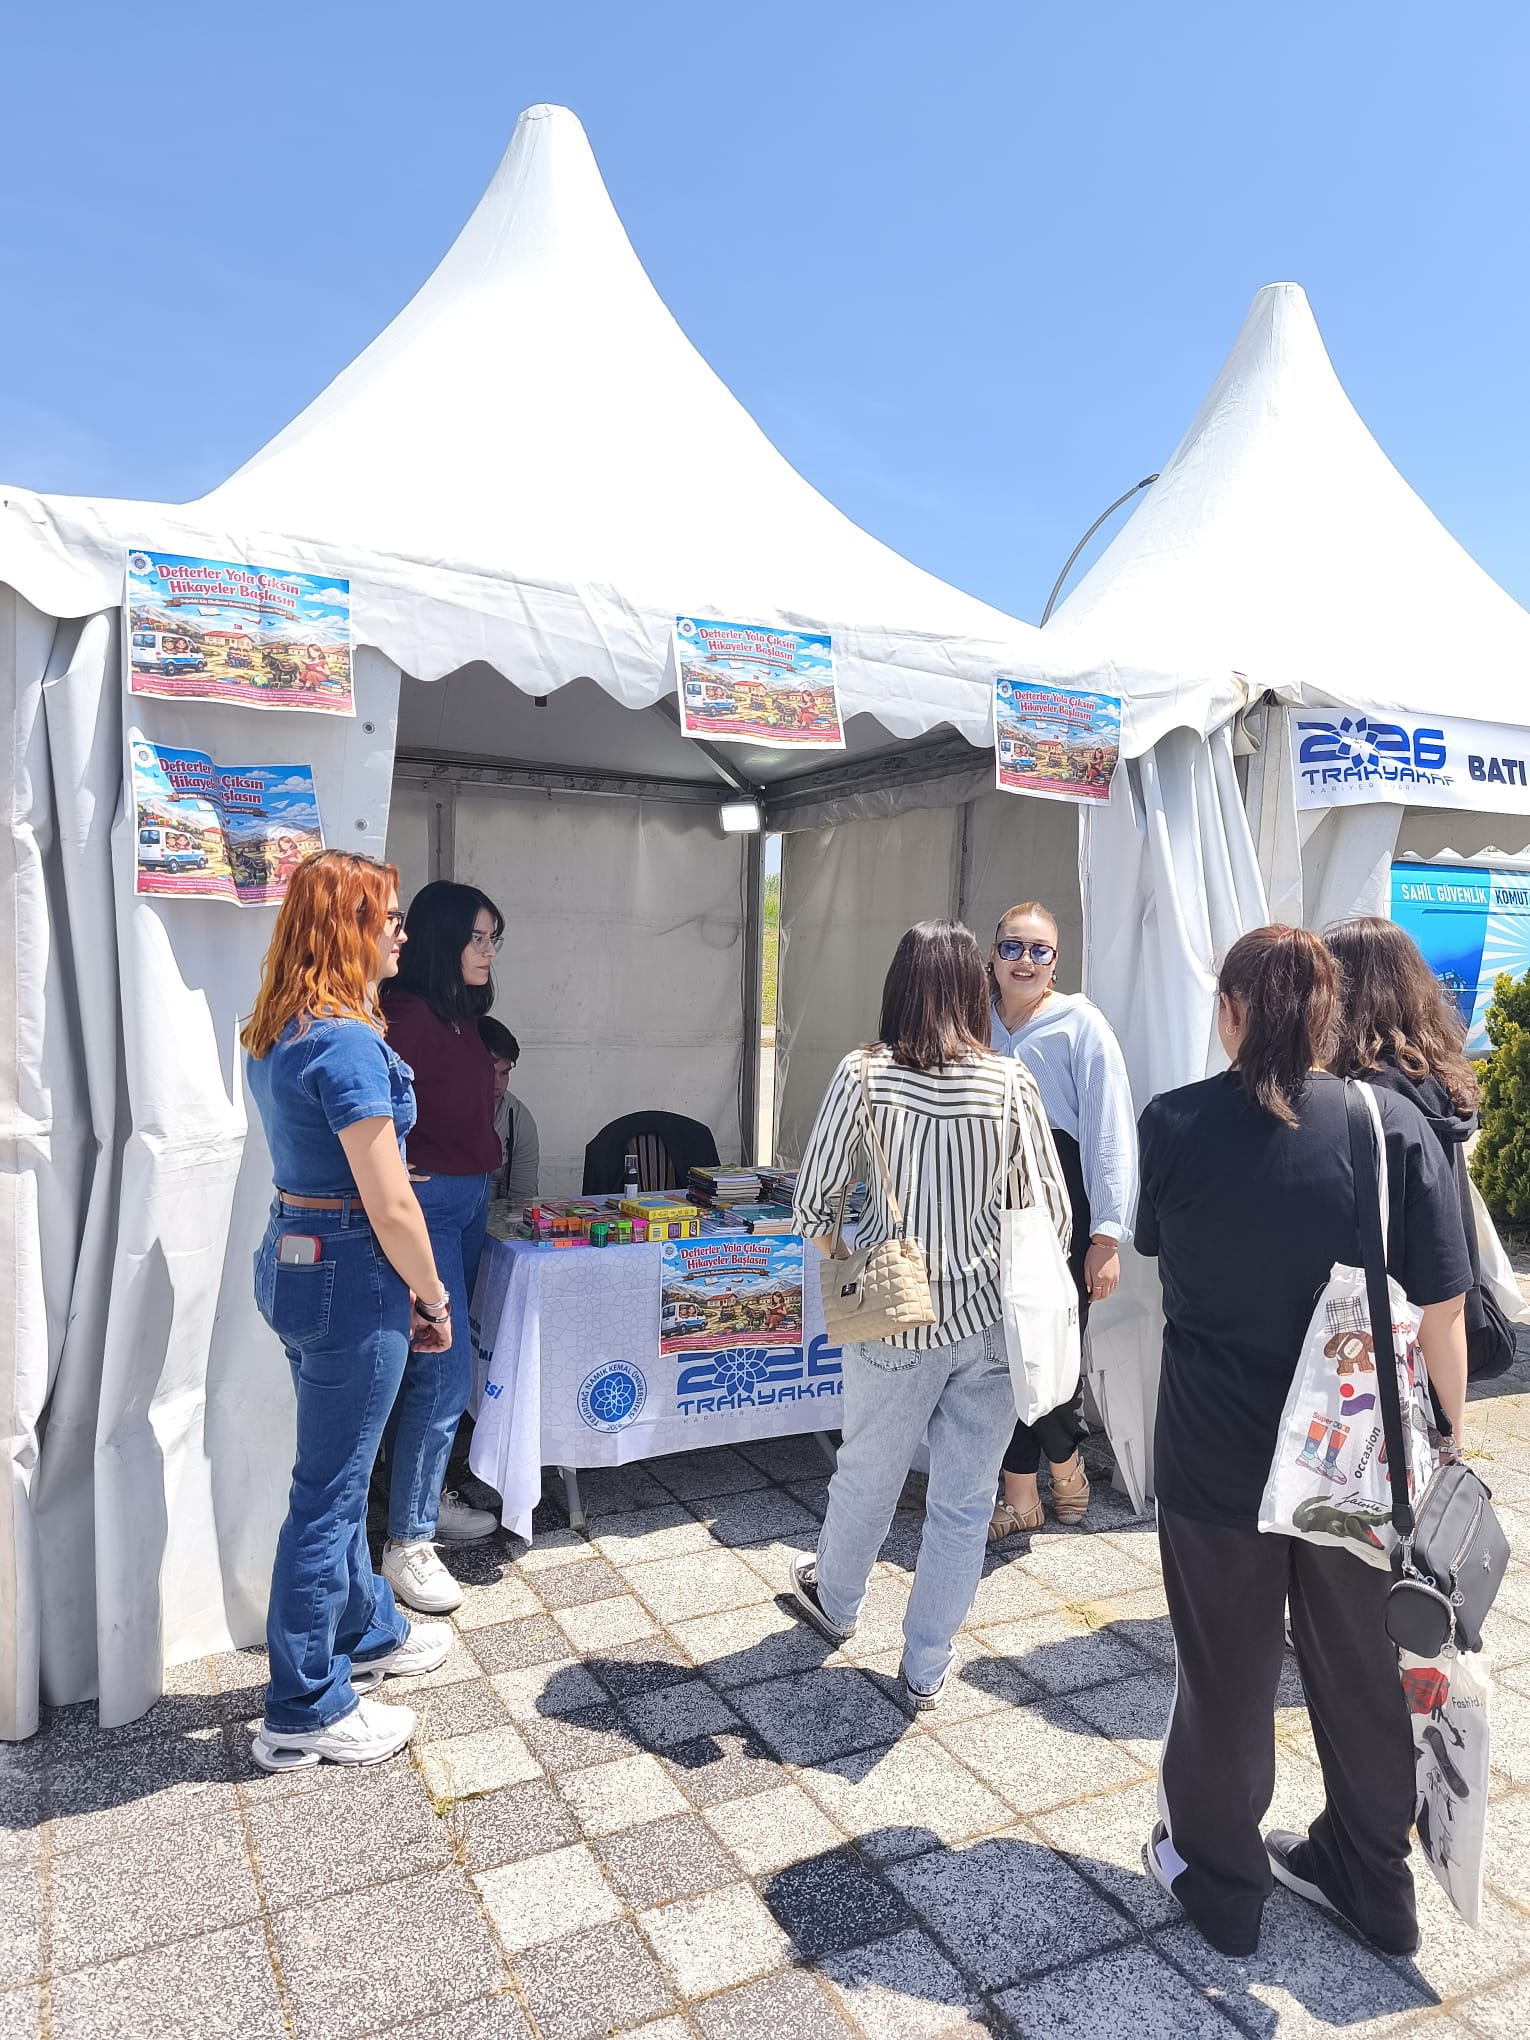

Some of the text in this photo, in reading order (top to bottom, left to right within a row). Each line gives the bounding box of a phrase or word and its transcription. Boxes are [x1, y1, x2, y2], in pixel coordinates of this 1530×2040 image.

[157, 565, 300, 596] Defterler Yola Çıksın
[169, 580, 236, 598] Hikayeler
[239, 587, 296, 608] Başlasın
[700, 628, 795, 650] Defterler Yola Çıksın
[708, 640, 793, 661] Hikayeler Başlasın
[1014, 690, 1095, 711] Defterler Yola Çıksın
[1020, 702, 1092, 721] Hikayeler Başlasın
[159, 758, 211, 774] Defterler
[222, 775, 263, 790] Çıksın
[1468, 755, 1528, 786] BATI
[1401, 882, 1435, 901] SAHİL
[1436, 884, 1487, 904] GÜVENLİK
[681, 1242, 770, 1259] Defterler Yola Çıksın
[687, 1254, 767, 1270] Hikayeler Başlasın
[608, 1364, 632, 1375] KEMAL
[1312, 1411, 1333, 1425] Super
[1354, 1426, 1381, 1479] occasion
